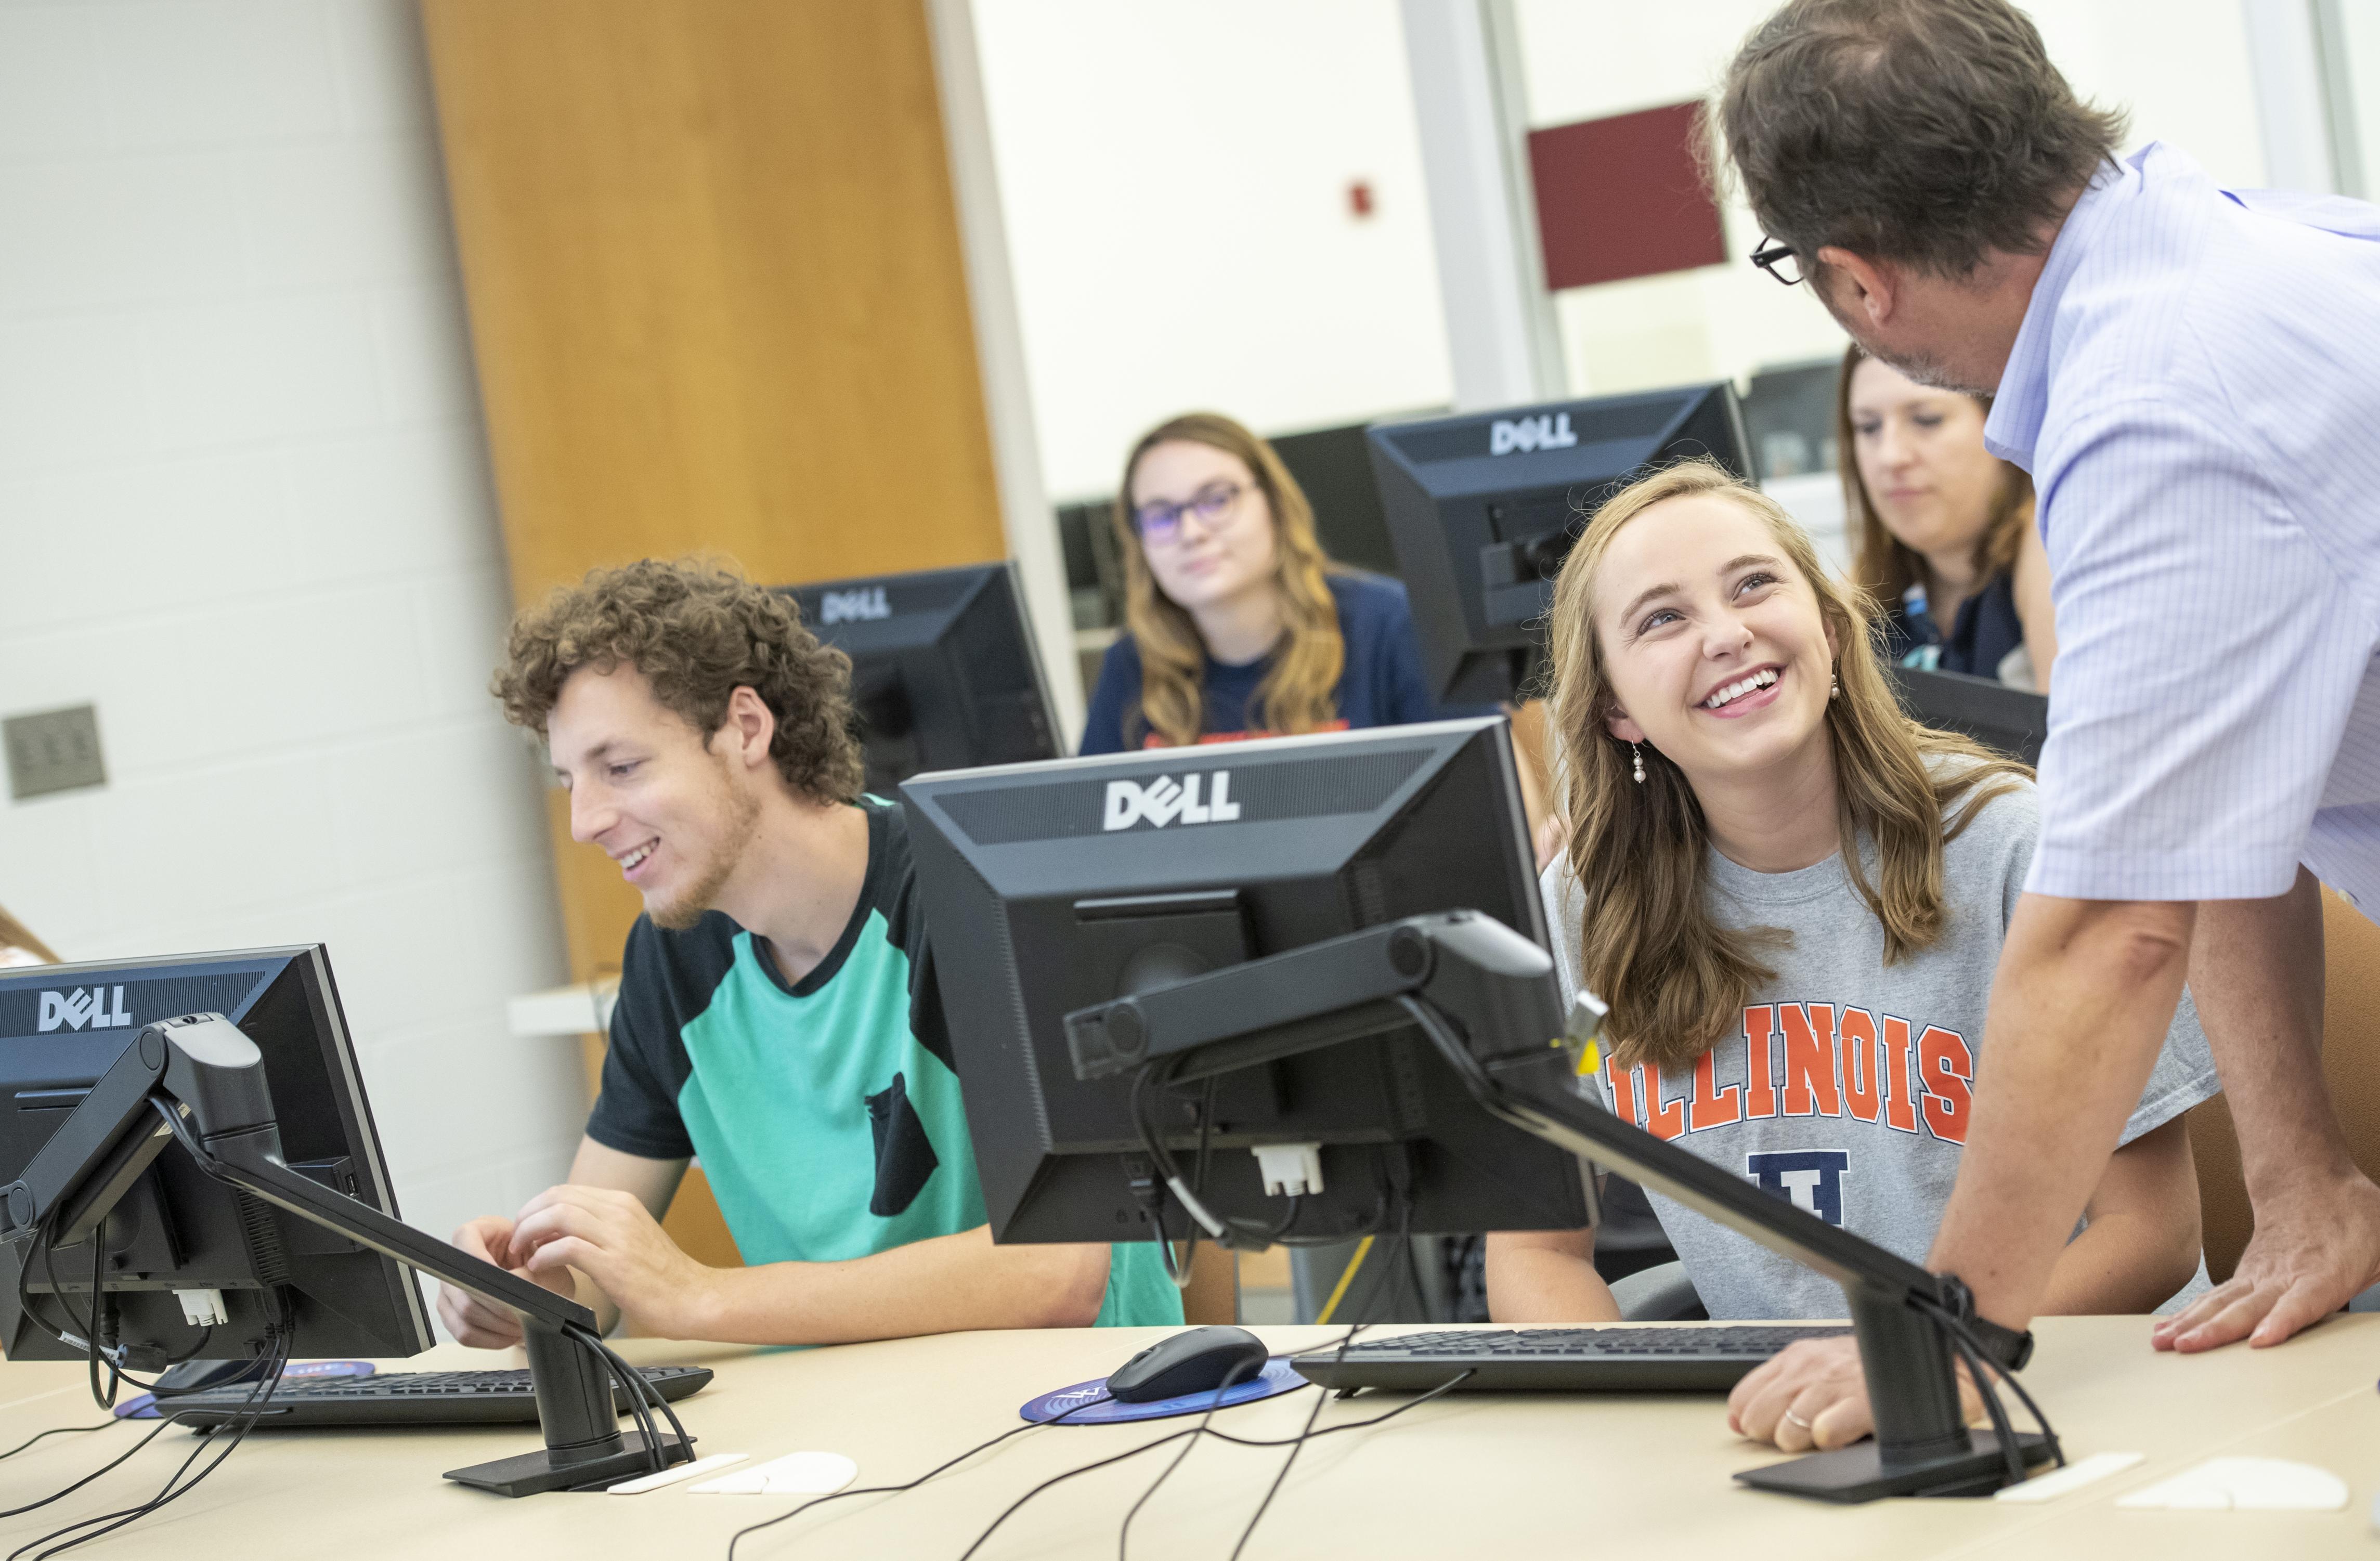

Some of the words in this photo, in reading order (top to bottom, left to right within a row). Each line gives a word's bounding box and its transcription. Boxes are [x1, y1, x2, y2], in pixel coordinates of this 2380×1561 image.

[1491, 412, 1577, 456] DELL
[822, 587, 891, 623] DELL
[1104, 771, 1240, 831] DELL
[38, 985, 131, 1032] DELL
[1605, 1001, 1974, 1146] ILLINOIS
